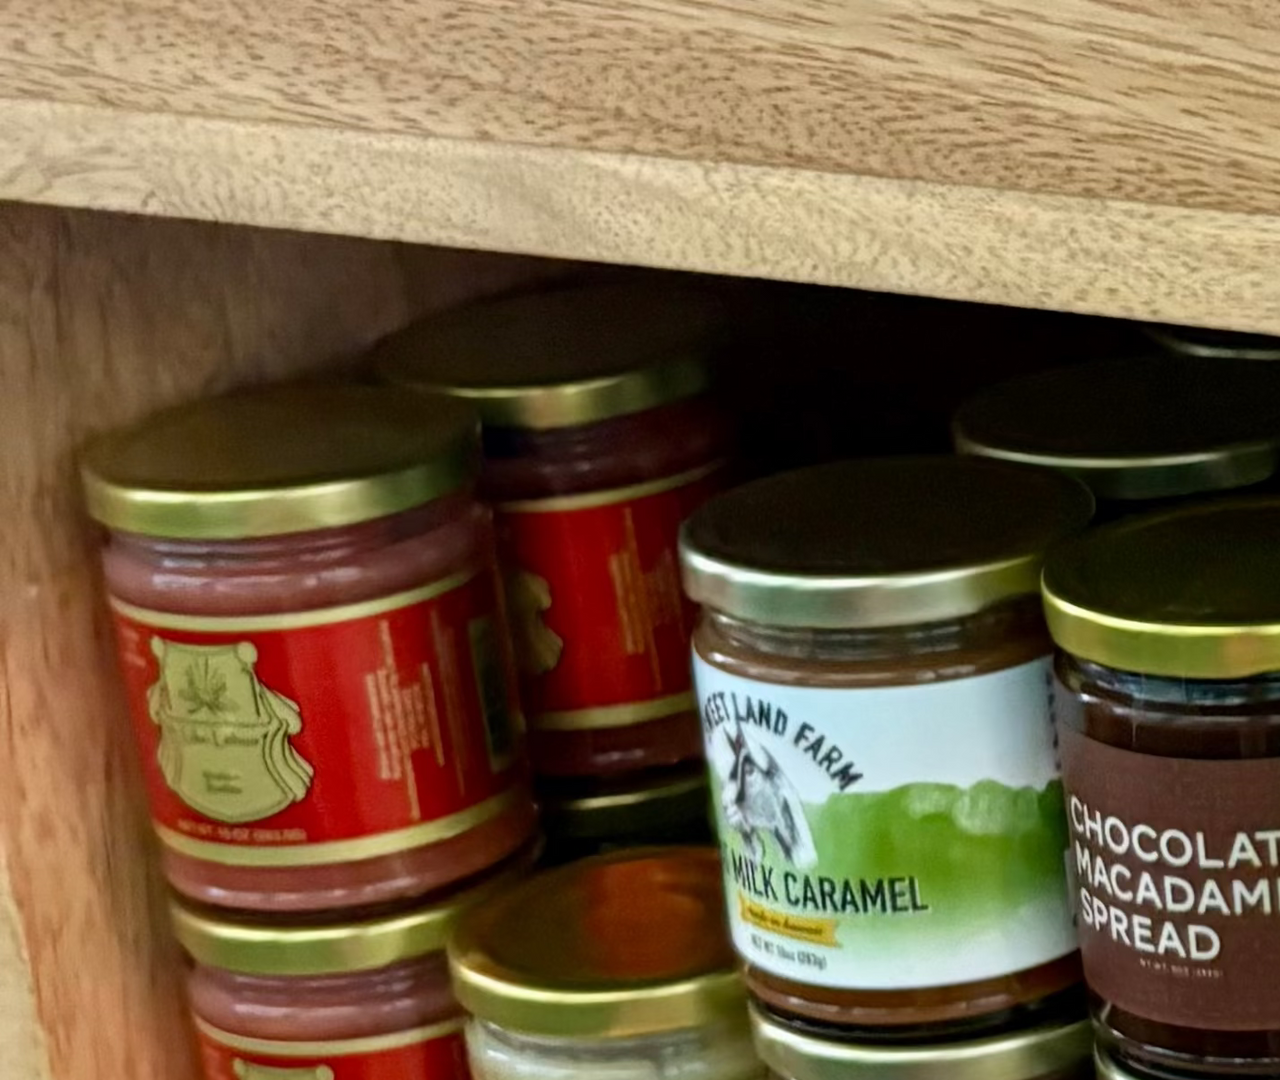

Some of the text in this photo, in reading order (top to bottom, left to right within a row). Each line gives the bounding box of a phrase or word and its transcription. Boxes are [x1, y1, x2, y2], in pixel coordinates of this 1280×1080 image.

[731, 690, 863, 792] LAND FARM
[783, 871, 929, 914] CARAMEL
[1080, 887, 1221, 961] SPREAD
